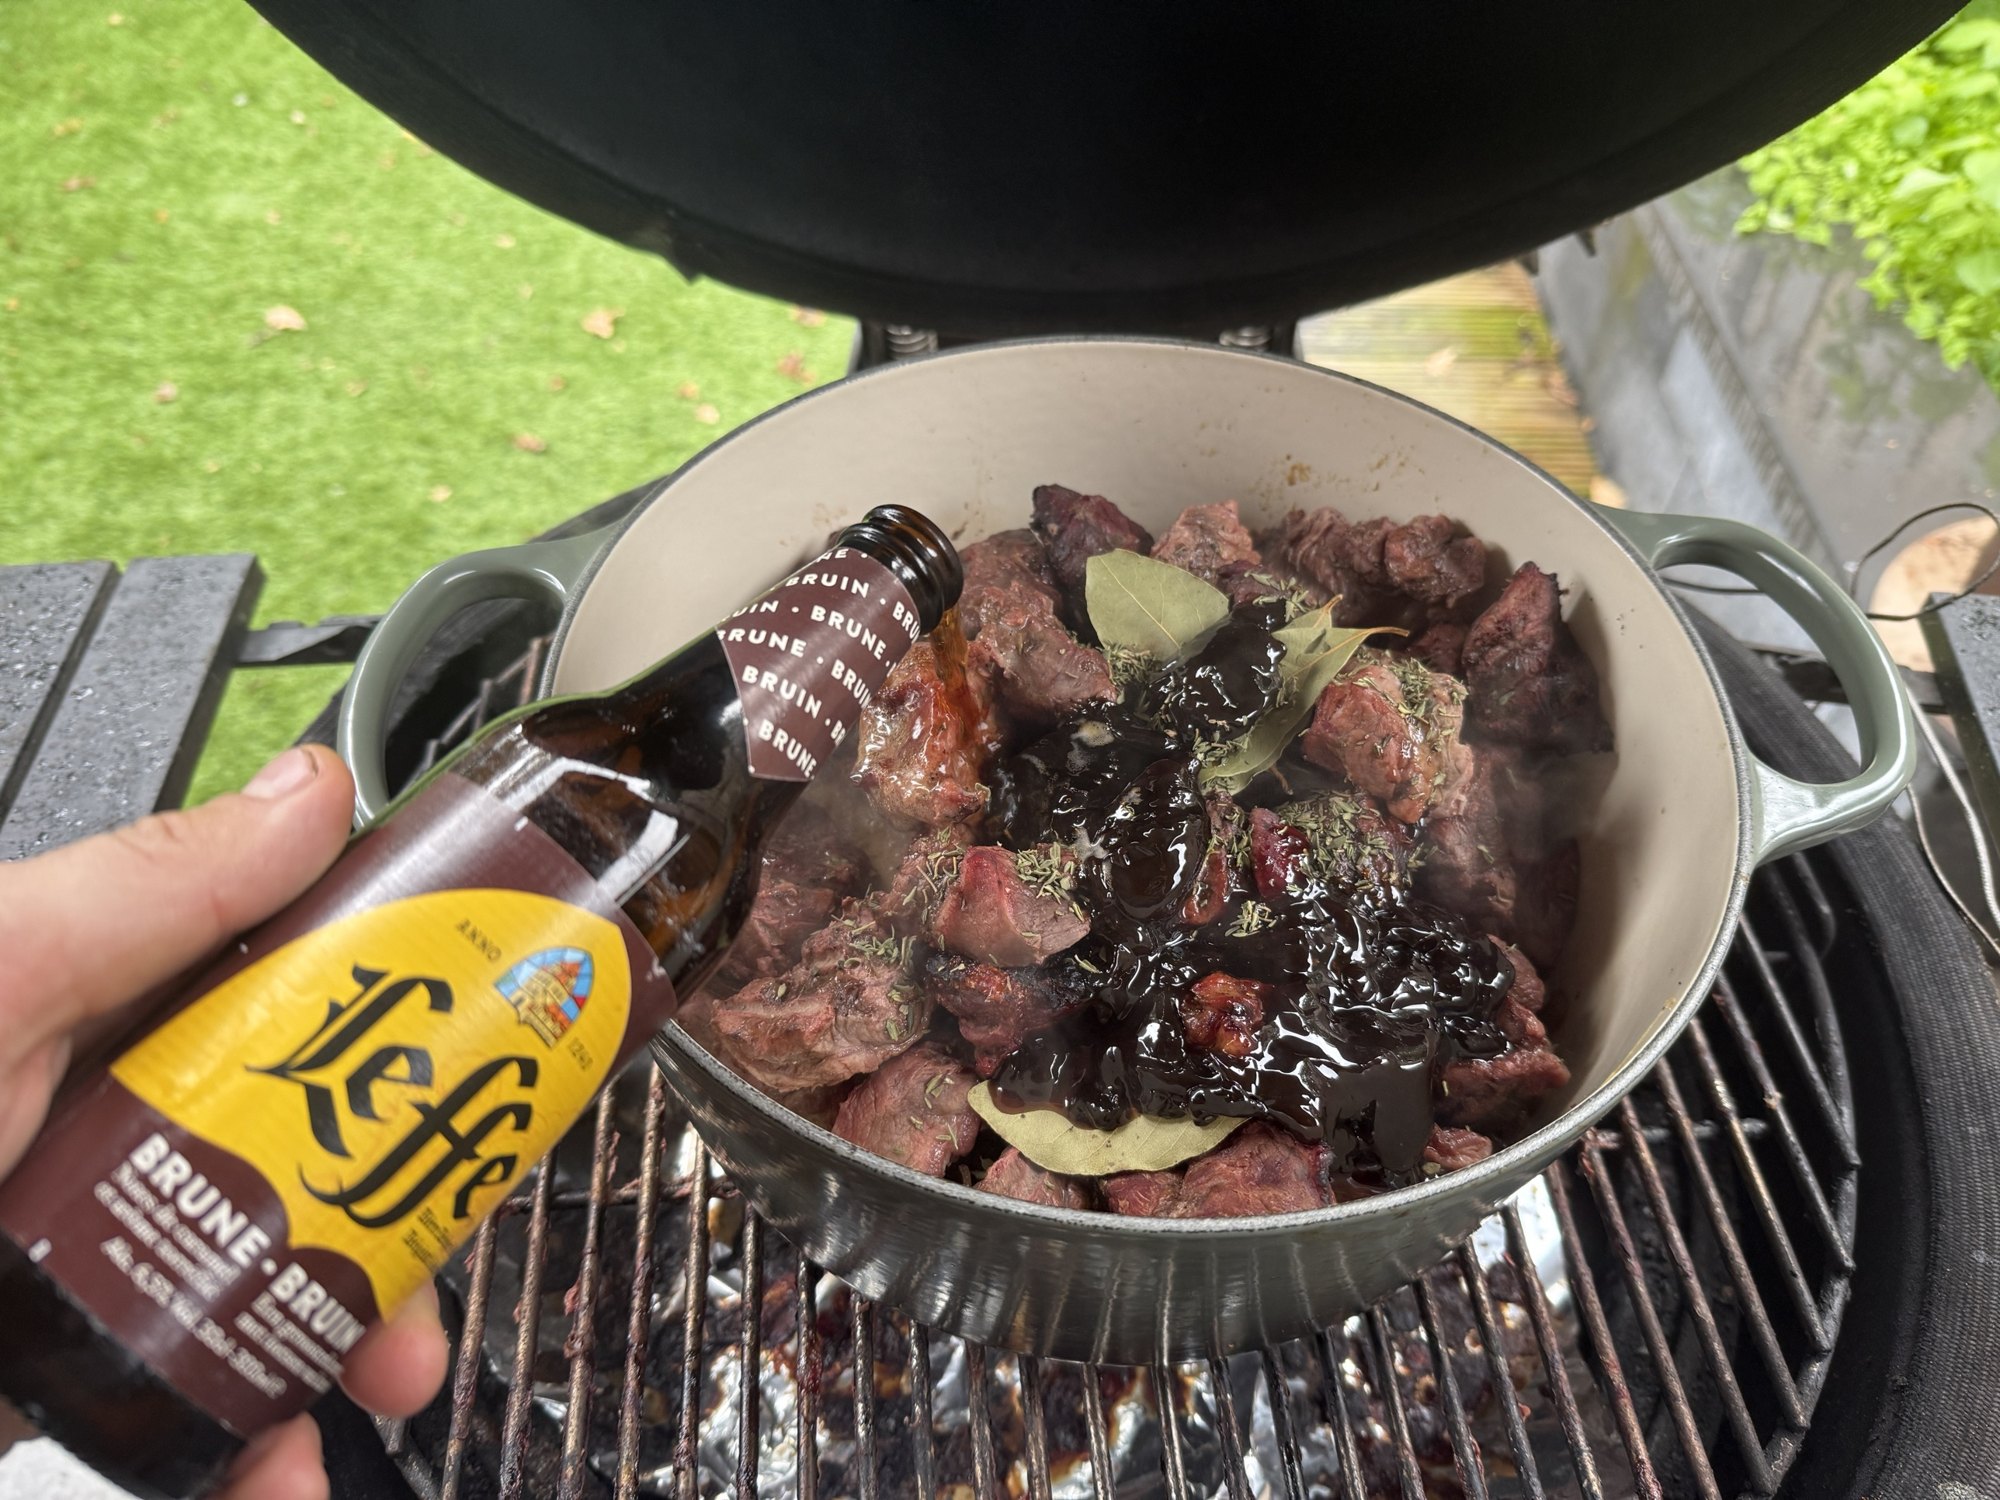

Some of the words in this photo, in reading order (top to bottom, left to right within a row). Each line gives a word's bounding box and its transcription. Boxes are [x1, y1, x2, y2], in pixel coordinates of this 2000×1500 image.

[785, 573, 869, 598] BRUIN
[811, 605, 887, 660] BRUNE
[742, 665, 822, 718] BRUIN
[831, 659, 873, 709] BRUIN
[758, 719, 817, 778] BRUNE
[455, 918, 502, 963] ANNO
[244, 963, 539, 1229] Leffe
[129, 1132, 271, 1268] BRUNE
[268, 1262, 366, 1354] BRUIN
